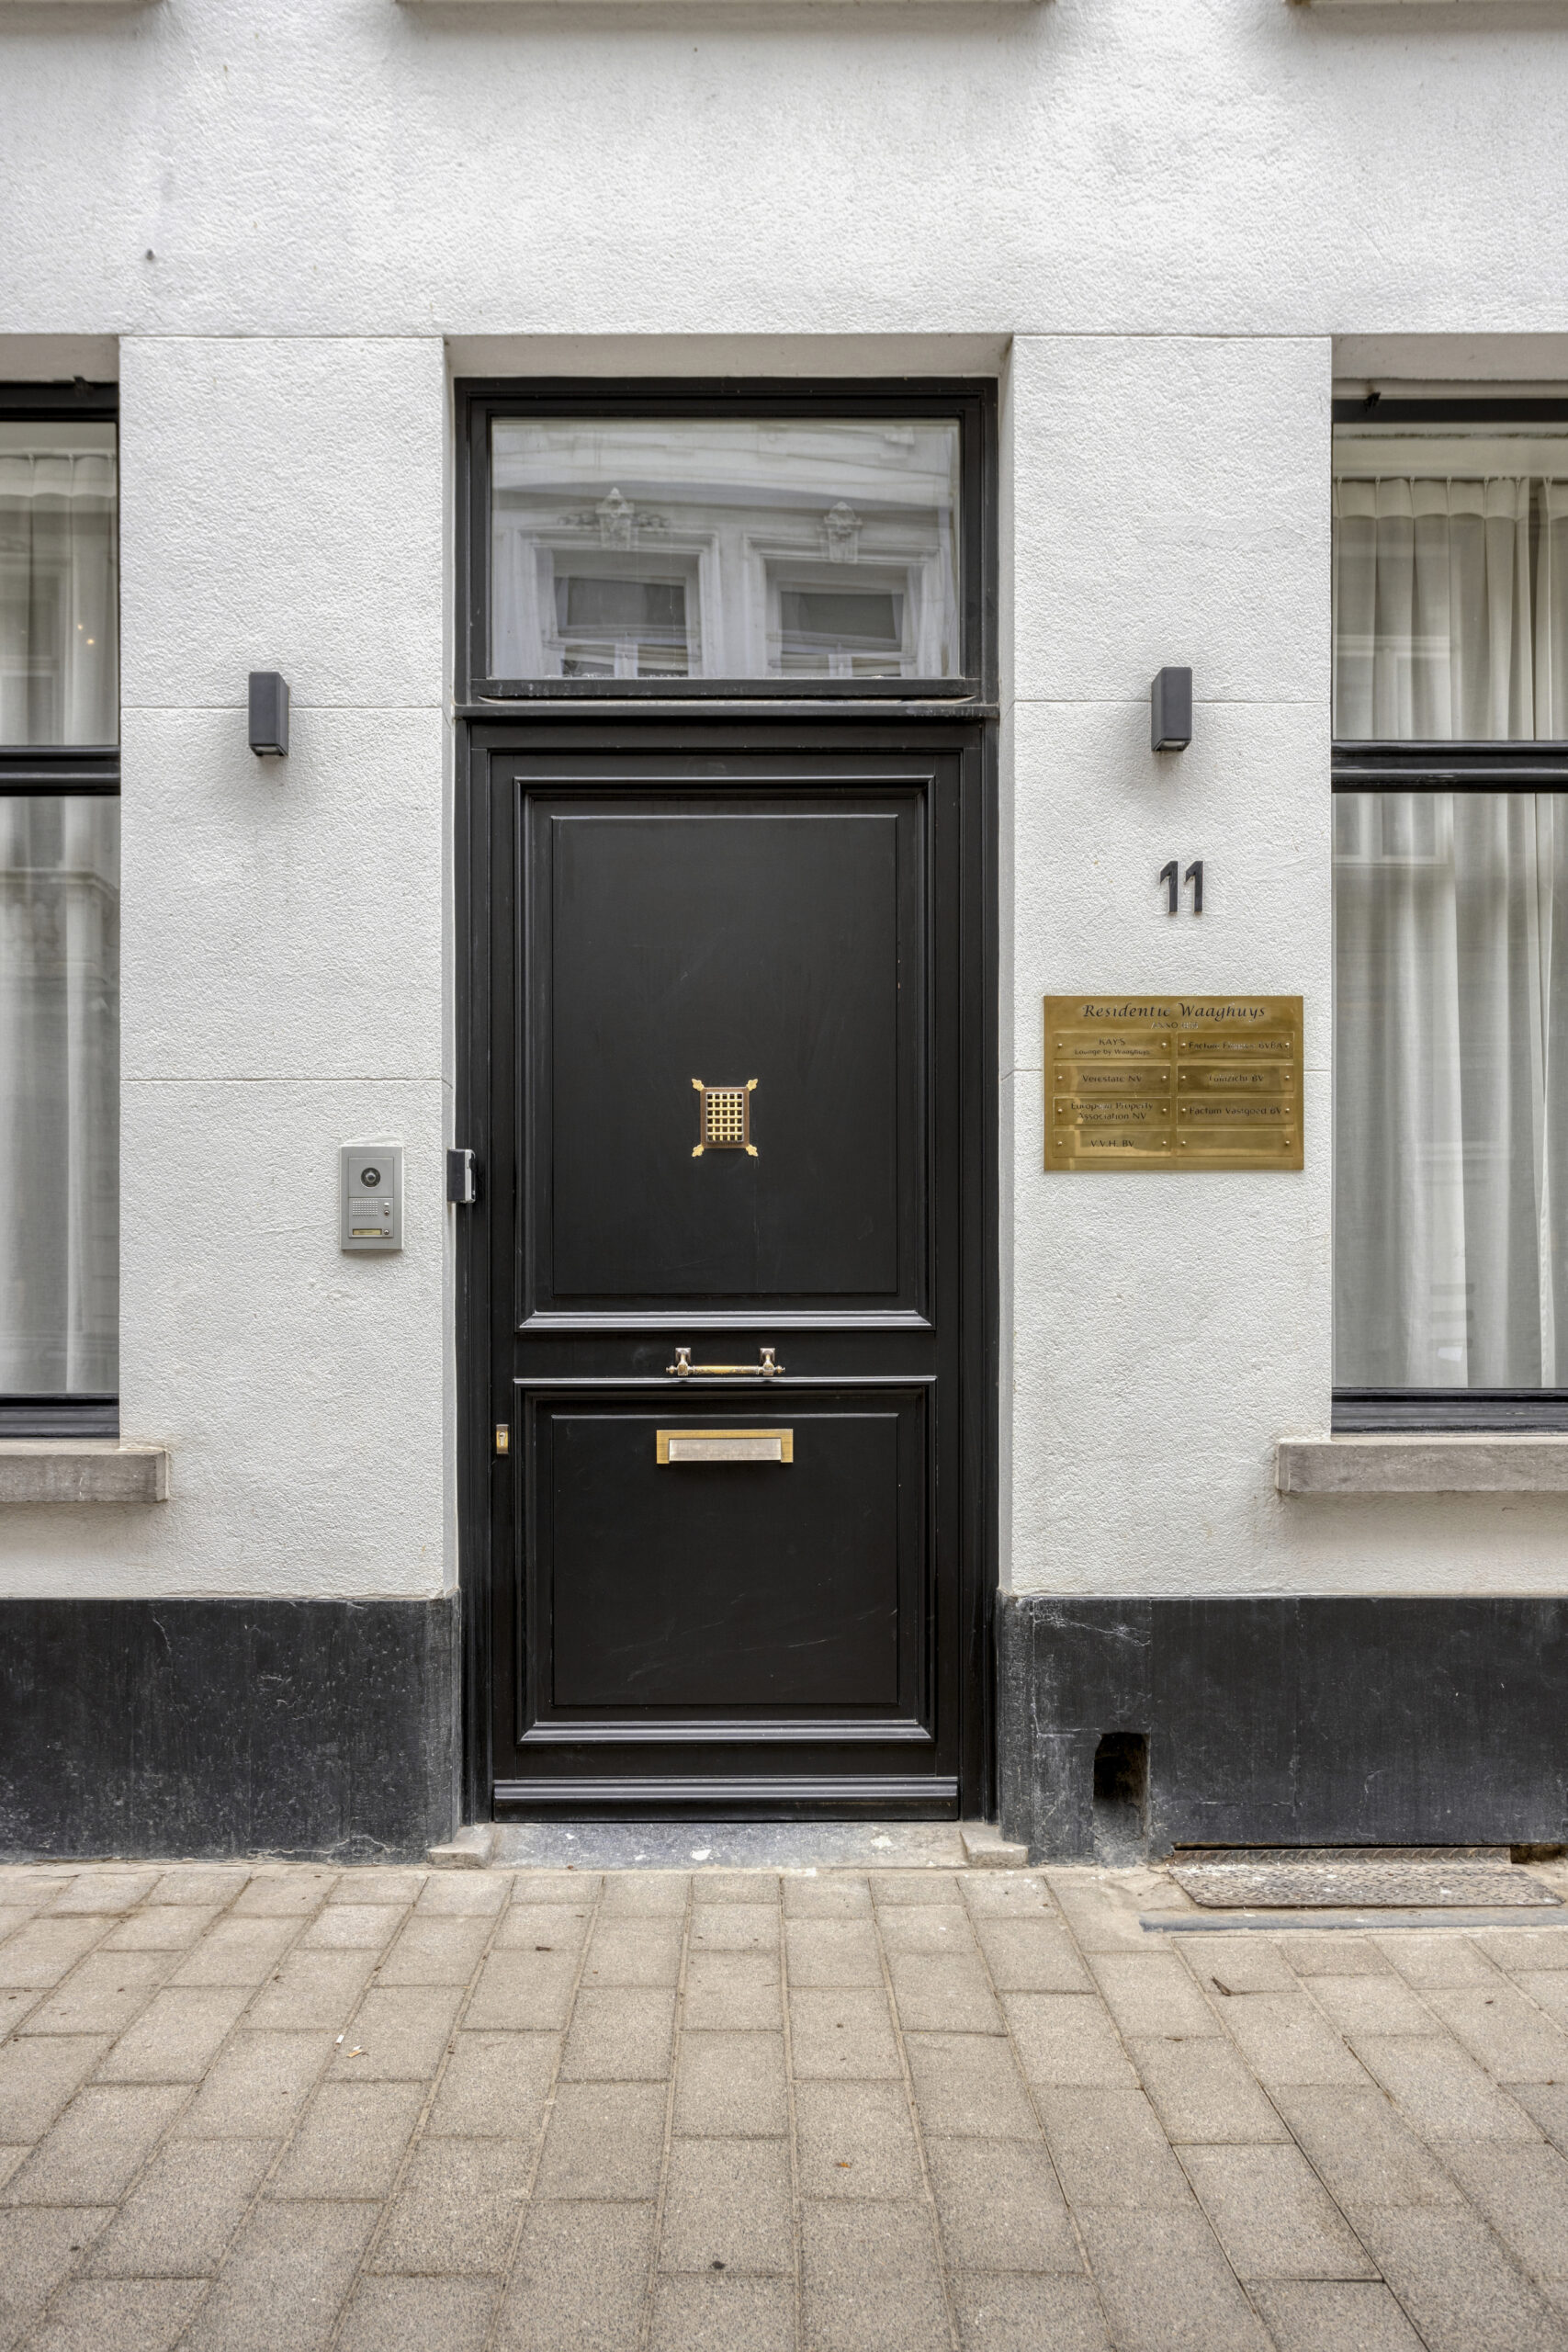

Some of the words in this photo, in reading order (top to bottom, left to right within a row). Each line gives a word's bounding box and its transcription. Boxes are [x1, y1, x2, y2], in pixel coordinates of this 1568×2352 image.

[1160, 860, 1203, 912] 11
[1082, 1002, 1171, 1017] Residentie
[1178, 1002, 1266, 1023] Waaghuys
[1102, 1048, 1112, 1057] by
[1081, 1074, 1125, 1083] Verestate
[1128, 1074, 1143, 1082] NV
[1251, 1074, 1264, 1082] BV
[1070, 1102, 1112, 1112] European
[1115, 1102, 1154, 1112] Property
[1189, 1106, 1222, 1115] Factum
[1225, 1106, 1267, 1116] Vastgoed
[1269, 1106, 1282, 1115] BV
[1078, 1112, 1129, 1121] Association
[1132, 1112, 1147, 1121] NV
[1122, 1138, 1135, 1148] BV
